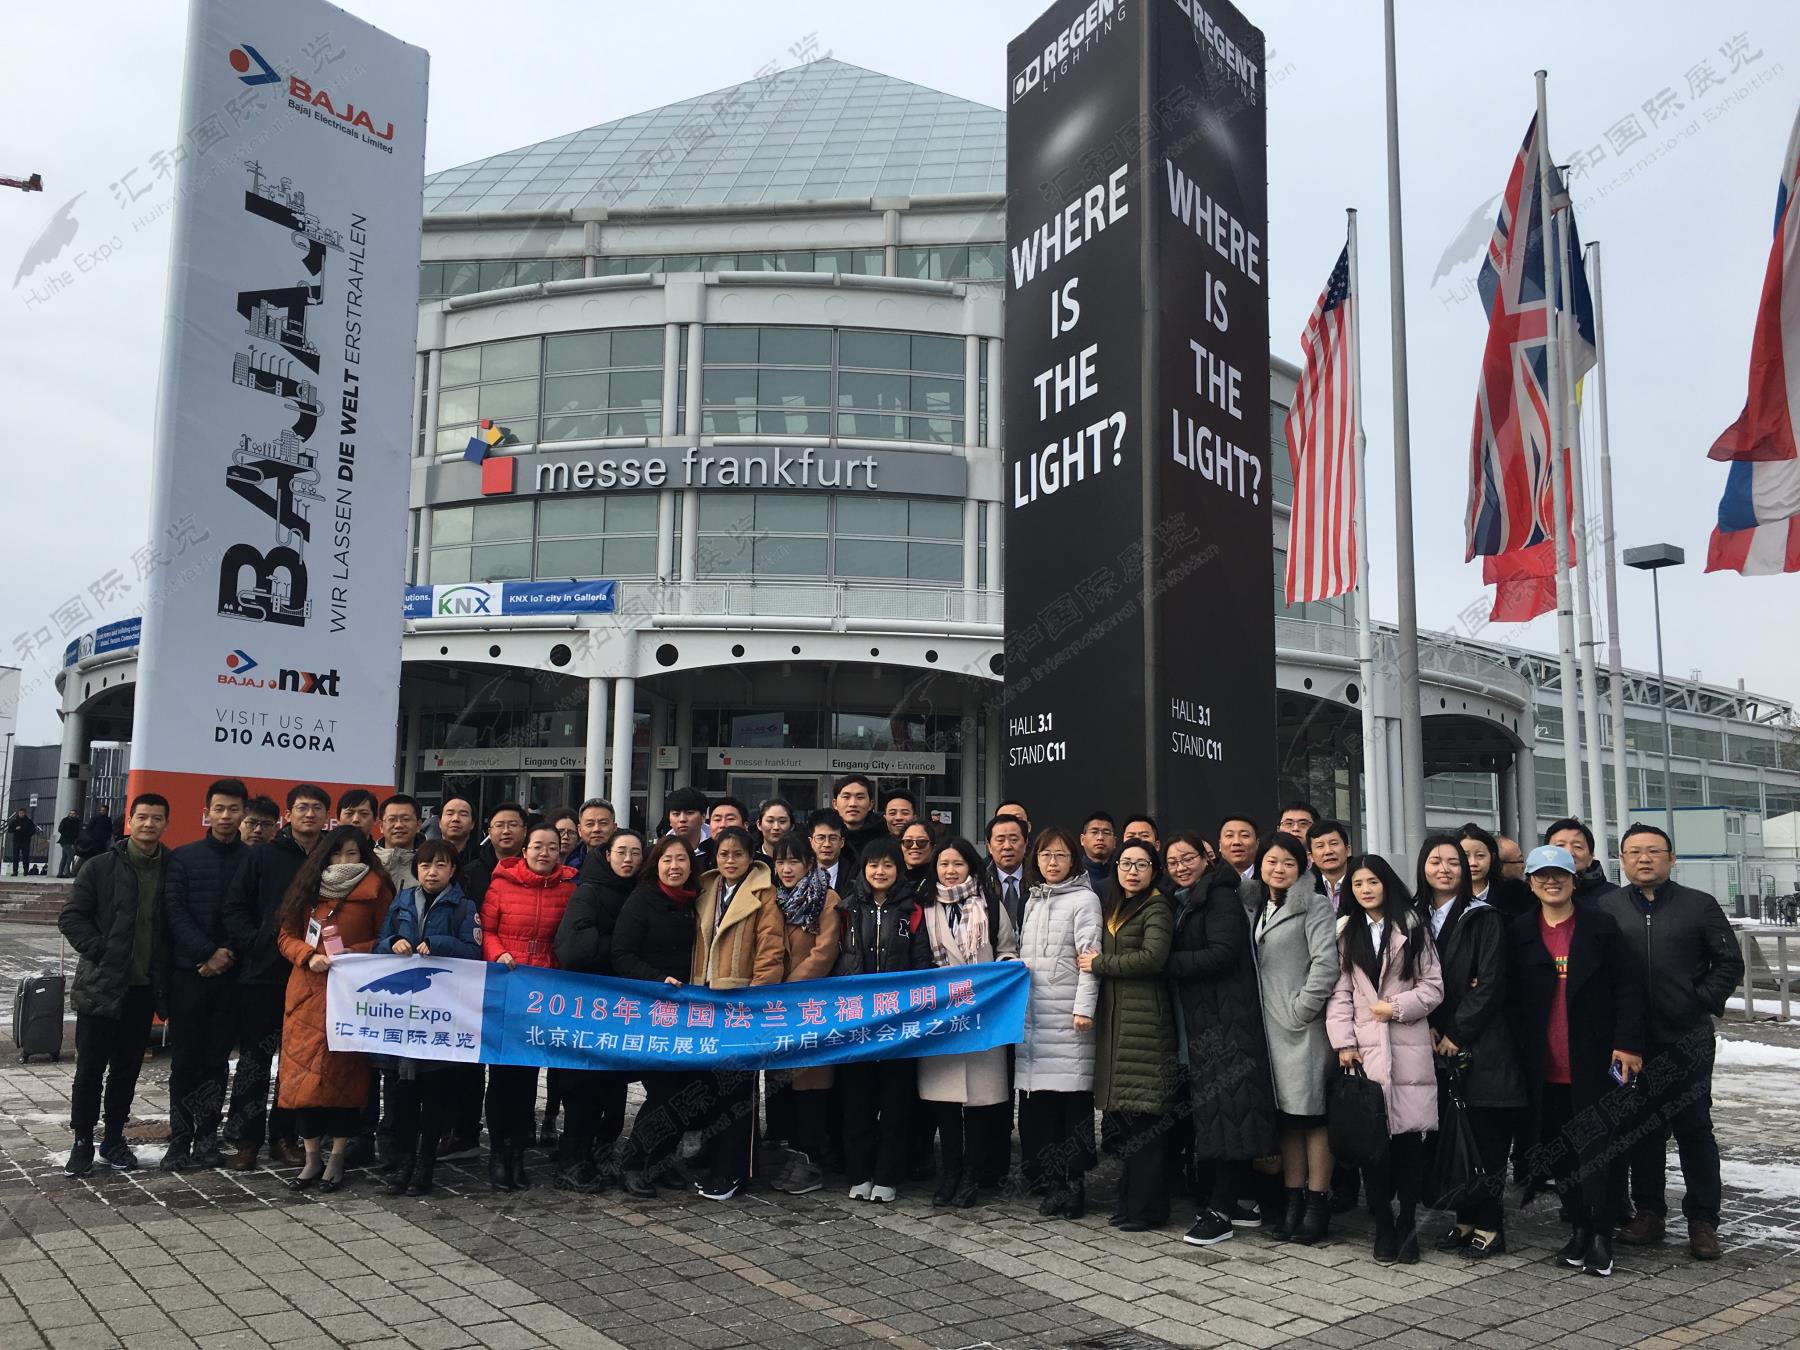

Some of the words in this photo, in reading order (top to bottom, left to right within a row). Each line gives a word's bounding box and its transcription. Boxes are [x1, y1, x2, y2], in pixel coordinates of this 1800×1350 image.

[1043, 5, 1126, 93] LIGHTING
[1194, 1, 1258, 90] REGENT
[1194, 29, 1257, 106] LIGHTING
[288, 75, 393, 141] BAJAJ
[288, 99, 312, 119] Bajaj
[313, 111, 359, 140] Electricals
[361, 132, 393, 155] Limited
[1011, 163, 1129, 290] WHERE
[1166, 158, 1260, 285] WHERE
[345, 212, 367, 365] ERSTRAHLEN
[1051, 277, 1081, 340] IS
[1205, 270, 1229, 333] IS
[340, 368, 360, 437] WELT
[1033, 343, 1098, 421] THE
[1189, 338, 1243, 420] THE
[217, 189, 326, 627] BAJAJ
[336, 447, 356, 483] DIE
[535, 457, 667, 491] messe
[682, 448, 879, 490] frankfurt
[1014, 411, 1127, 510] LIGHT?
[1172, 408, 1262, 506] LIGHT?
[332, 486, 354, 580] LASSEN
[330, 580, 348, 633] WIR
[438, 597, 490, 614] KNX
[509, 595, 528, 603] KNX
[530, 594, 543, 602] IoT
[545, 594, 561, 603] city
[563, 593, 572, 601] in
[573, 593, 607, 602] Galleria
[217, 674, 264, 689] BAJAJ
[279, 668, 340, 697] nxt
[215, 708, 270, 727] VISIT
[279, 713, 303, 730] US
[313, 719, 338, 734] AT
[1009, 716, 1036, 737] HALL
[1037, 712, 1053, 733] 3.1
[1171, 697, 1197, 724] HALL
[1197, 705, 1211, 727] 3.1
[214, 726, 253, 745] D10
[261, 731, 335, 753] AGORA
[524, 756, 558, 768] Eingang
[560, 756, 577, 767] City
[735, 759, 763, 767] messe
[765, 758, 802, 767] frankfurt
[832, 759, 869, 771] Eingang
[871, 760, 890, 771] City
[897, 761, 936, 771] Entrance
[1009, 744, 1045, 767] STAND
[1046, 741, 1066, 762] C11
[1171, 731, 1205, 759] STAND
[1206, 738, 1222, 762] C11
[356, 1001, 404, 1019] Huihe
[409, 1005, 452, 1025] Expo
[526, 979, 976, 1029] 2018年德国法兰克福照明展
[335, 1022, 476, 1050] 汇和国际展览
